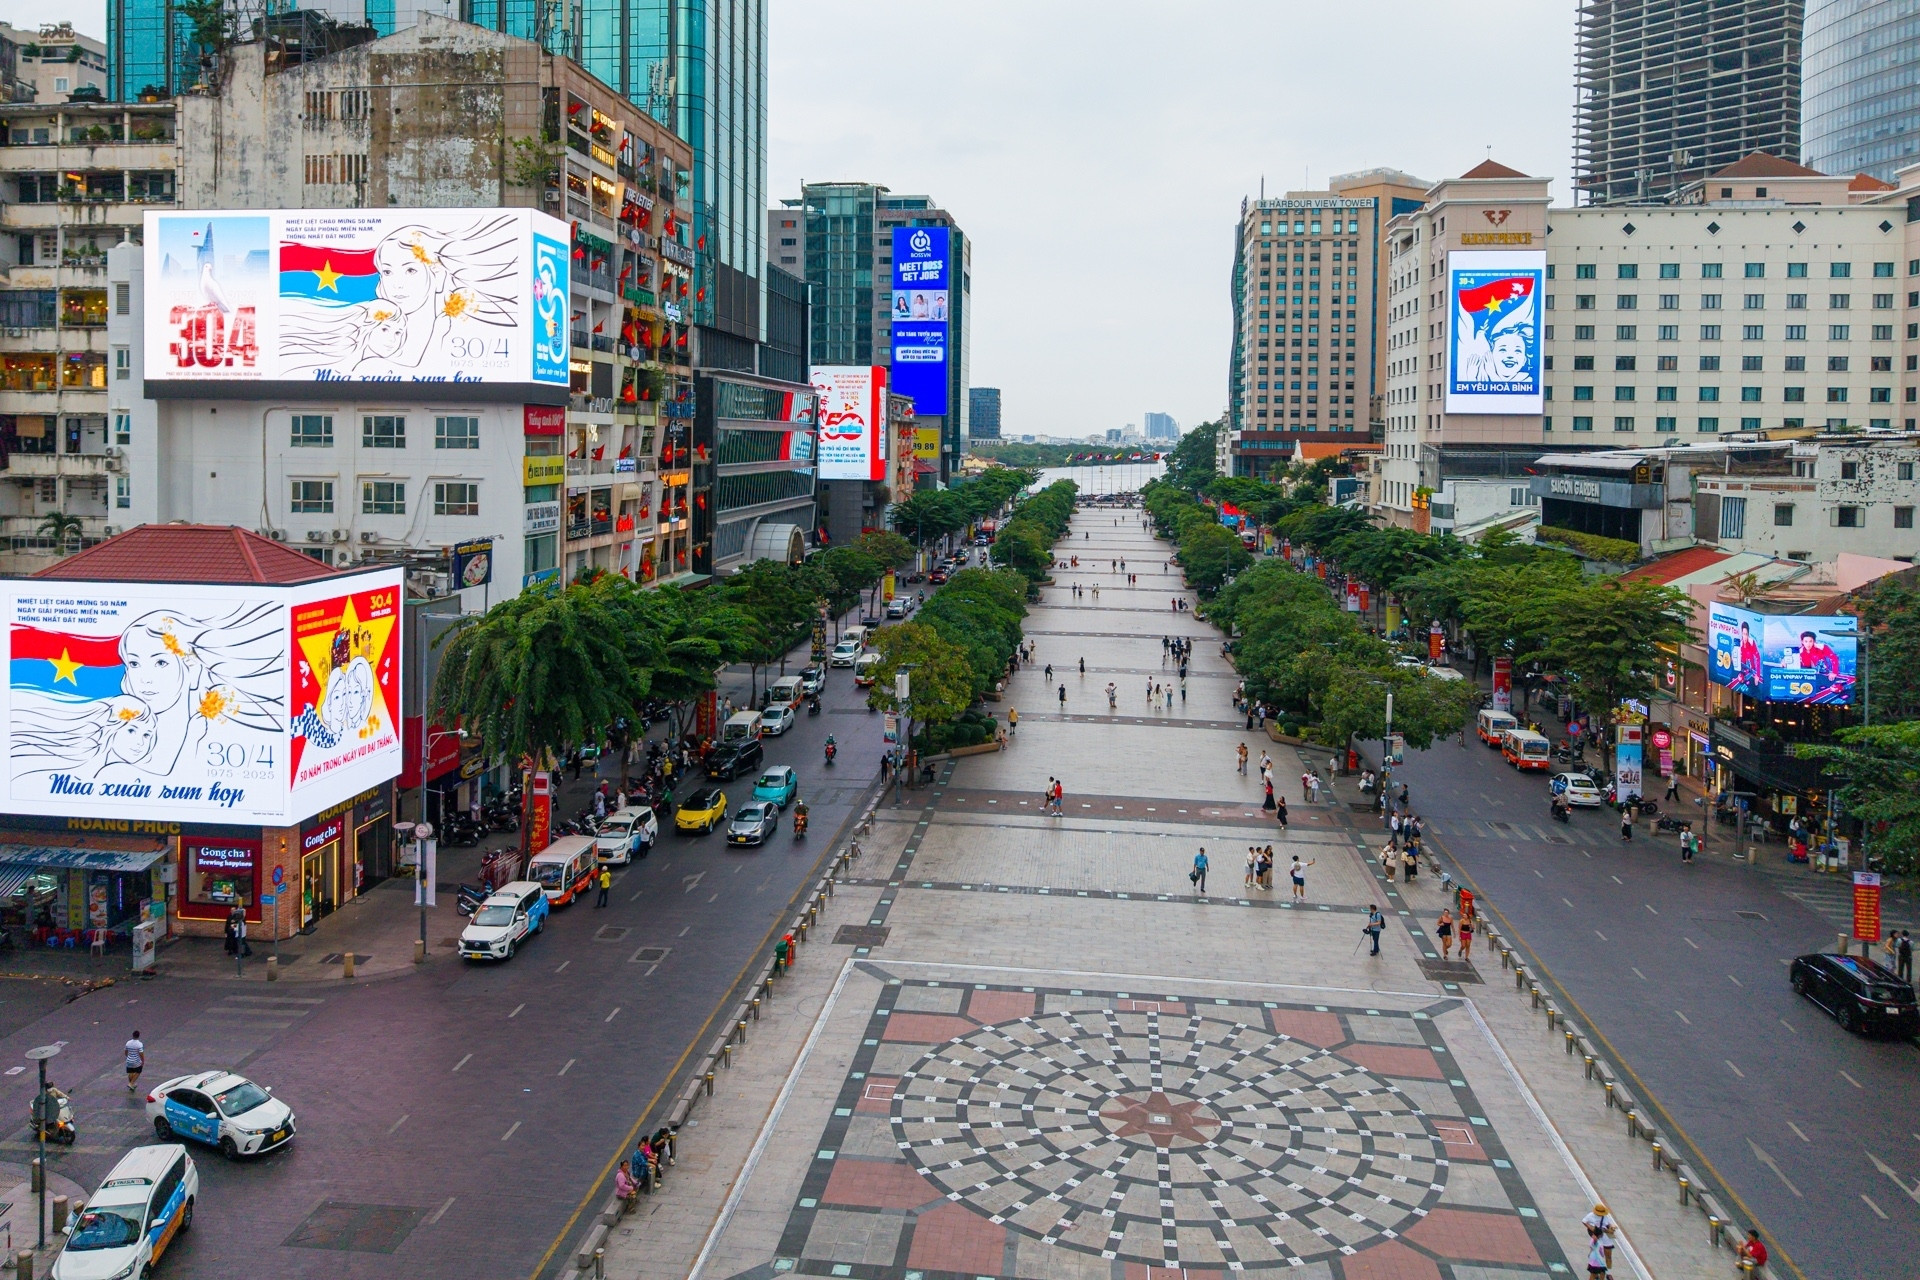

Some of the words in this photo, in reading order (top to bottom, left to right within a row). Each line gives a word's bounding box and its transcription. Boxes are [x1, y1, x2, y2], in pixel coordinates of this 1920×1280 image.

[1269, 199, 1312, 207] HARBOUR
[1315, 199, 1337, 207] VIEW
[1341, 199, 1371, 207] TOWER
[1498, 232, 1532, 244] PRINCE
[899, 262, 922, 272] MEET
[922, 260, 943, 270] BOSS
[903, 272, 918, 282] GET
[920, 271, 939, 280] JOBS
[170, 304, 259, 367] 30.4
[450, 336, 509, 359] 30/4
[1456, 381, 1469, 392] EM
[1471, 381, 1488, 392] YÊU
[1490, 381, 1510, 392] HOÀ
[1512, 381, 1532, 392] BÌNH
[1550, 479, 1573, 494] SAIGON
[1574, 480, 1600, 497] GARDEN
[370, 592, 392, 609] 30.4
[207, 742, 274, 769] 30/4
[300, 770, 307, 782] 50
[309, 763, 321, 778] NĂM
[323, 756, 341, 773] TRONG
[343, 749, 357, 763] NGÀY
[358, 746, 366, 758] VUI
[368, 742, 376, 755] ĐẠI
[377, 734, 393, 749] THẮNG
[207, 769, 233, 778] 1975
[243, 770, 275, 779] 2025
[49, 773, 94, 795] Mùa
[99, 778, 152, 798] xuân
[158, 785, 202, 800] sum
[208, 781, 245, 808] họp
[305, 834, 324, 848] Gong
[325, 826, 336, 838] cha
[201, 847, 227, 859] Gong
[228, 849, 244, 858] cha
[198, 859, 224, 867] Brewing
